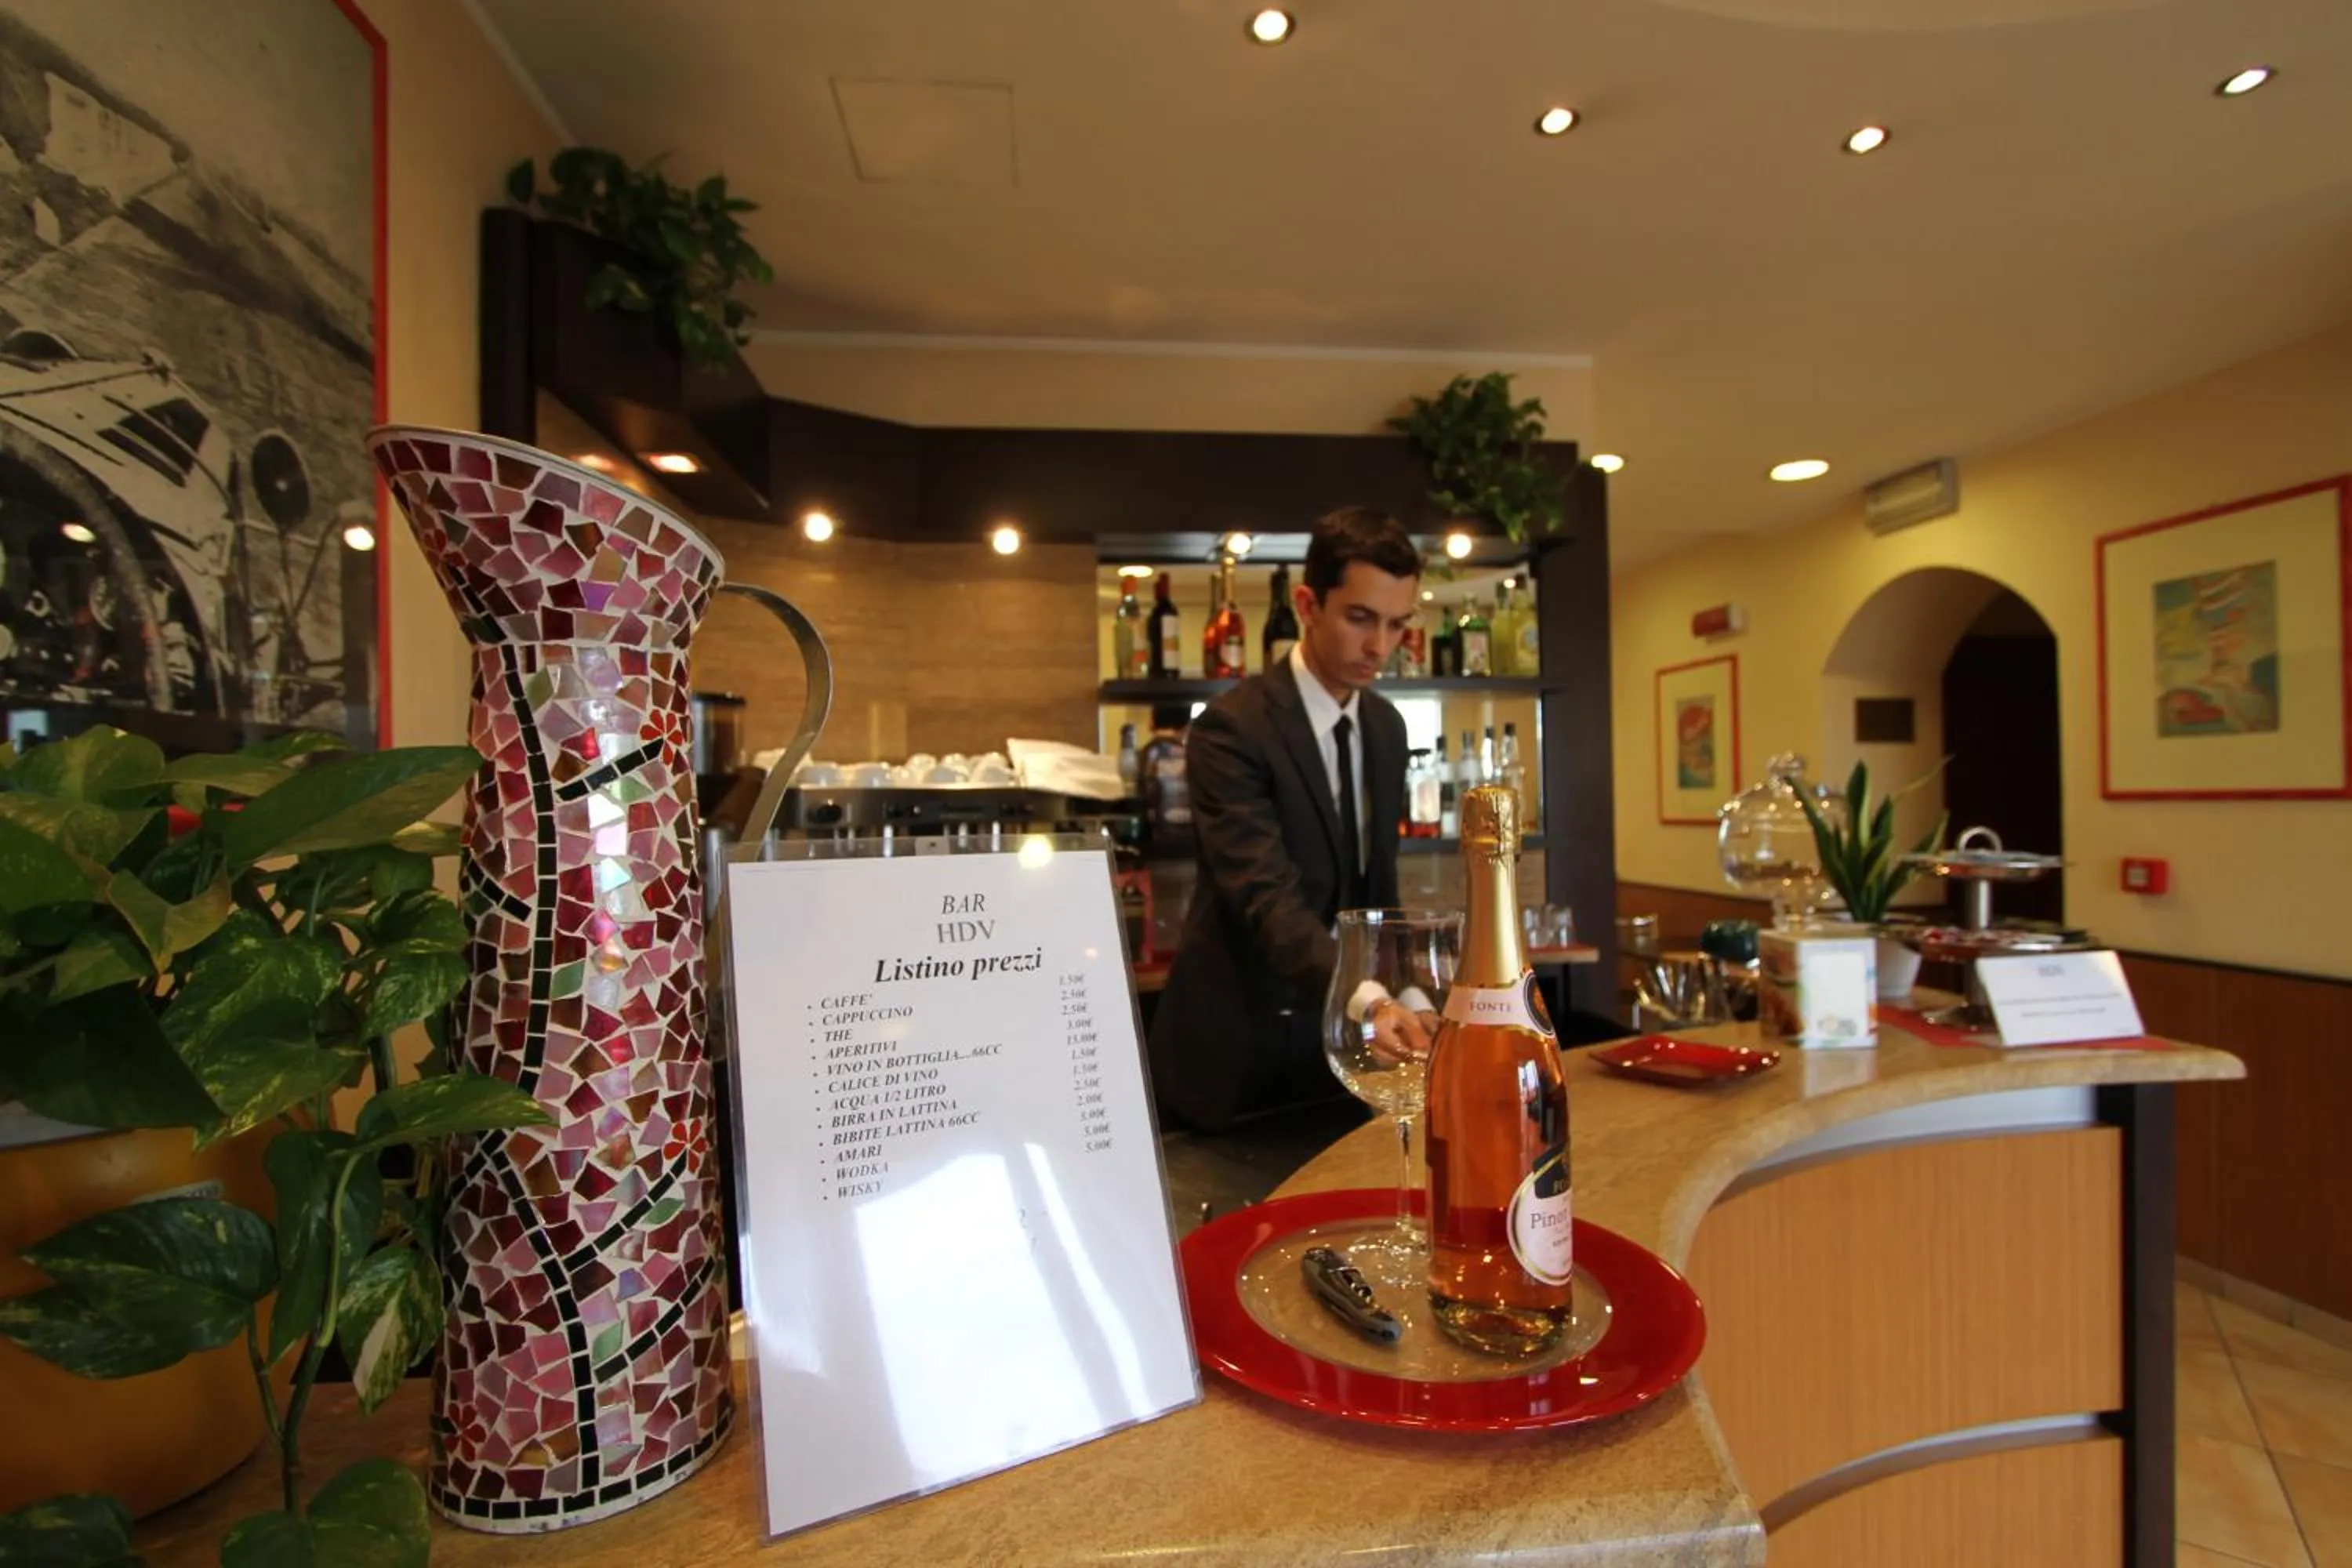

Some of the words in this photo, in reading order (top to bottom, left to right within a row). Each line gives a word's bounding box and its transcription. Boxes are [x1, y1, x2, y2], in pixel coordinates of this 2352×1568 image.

[942, 893, 985, 915] BAR
[937, 919, 996, 943] HDV
[874, 956, 964, 983] Listino
[971, 947, 1042, 981] prezzi
[821, 993, 873, 1010] CAFFE'
[822, 1006, 914, 1026] CAPPUCCINO
[823, 1029, 854, 1043] THE
[827, 1040, 897, 1059] APERITIVI
[827, 1062, 863, 1076] VINO
[867, 1058, 882, 1072] IN
[828, 1076, 880, 1094] CALICE
[885, 1073, 900, 1087] DI
[903, 1068, 938, 1083] VINO
[829, 1092, 880, 1111] ACQUA
[906, 1085, 947, 1100] LITRO
[831, 1112, 875, 1128] BIRRA
[880, 1108, 895, 1120] IN
[899, 1098, 957, 1118] LATTINA
[833, 1127, 882, 1145] BIBITE
[886, 1118, 946, 1137] LATTINA
[835, 1144, 882, 1163] AMARI
[837, 1162, 889, 1180] WODKA
[838, 1180, 883, 1199] WISKY
